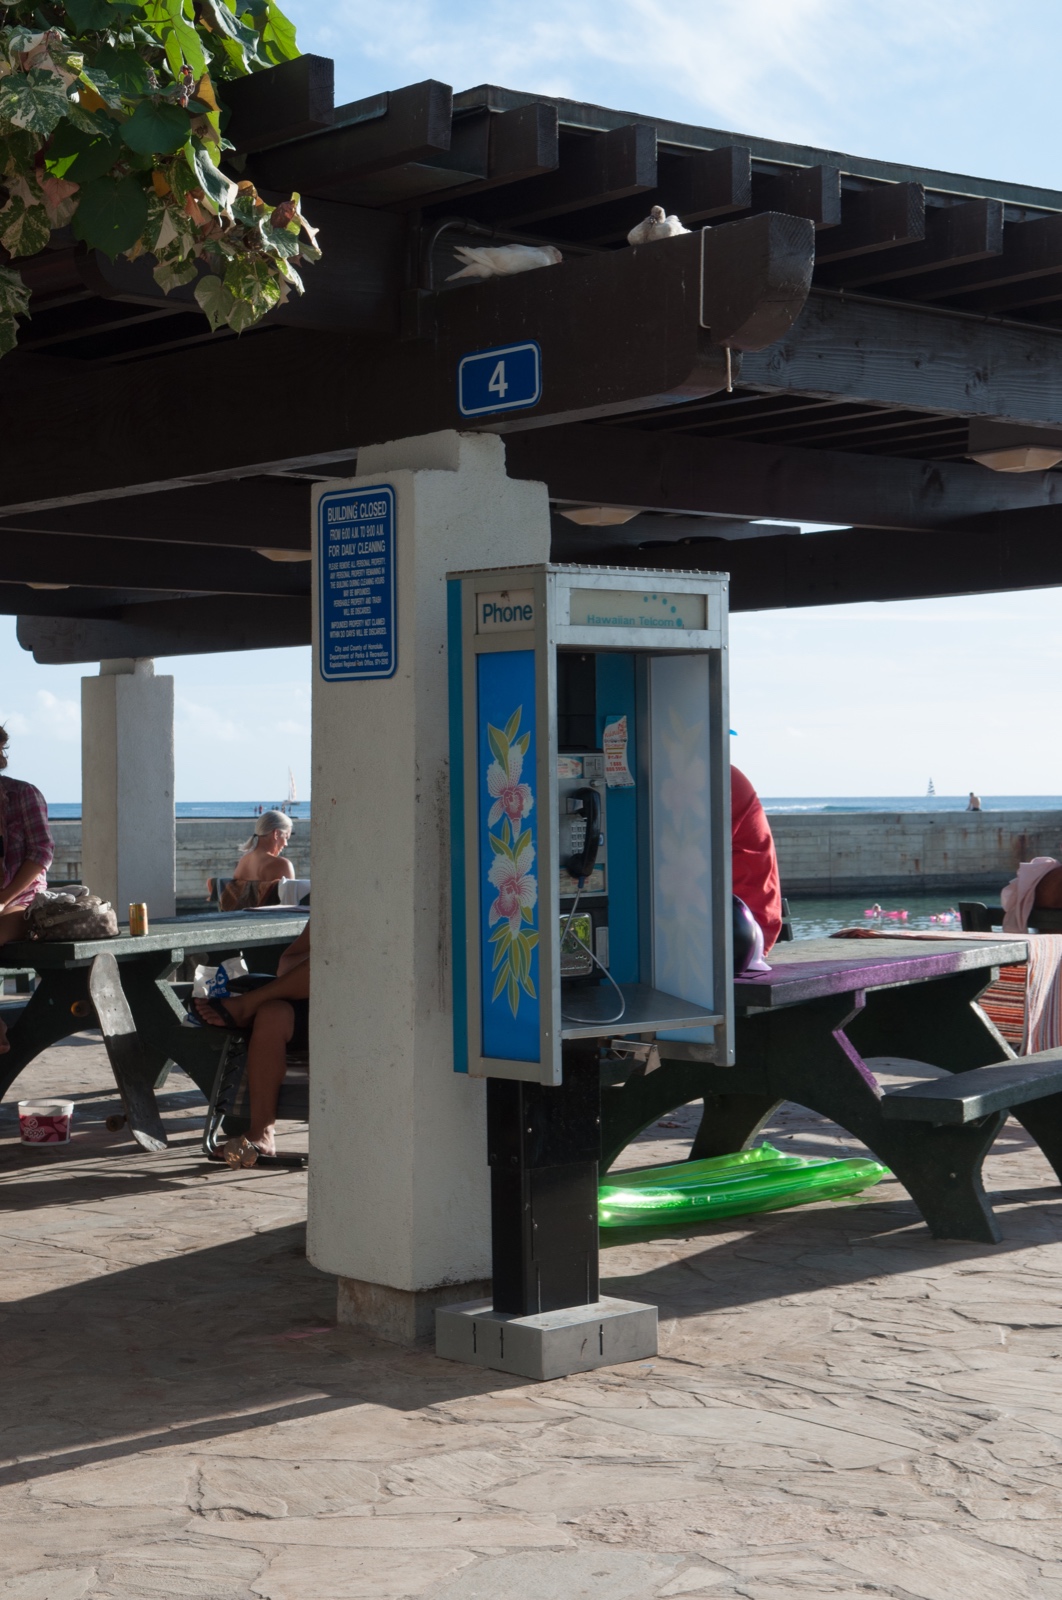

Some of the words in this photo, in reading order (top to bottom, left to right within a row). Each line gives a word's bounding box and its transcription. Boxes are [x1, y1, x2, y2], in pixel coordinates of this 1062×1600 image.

[488, 360, 508, 398] 4
[328, 505, 358, 522] BUILDING
[360, 501, 387, 518] CLOSED
[330, 529, 340, 540] FROM
[360, 526, 365, 537] TO
[329, 545, 340, 557] FOR
[342, 543, 356, 556] DAILY
[358, 540, 386, 554] CLEANING
[356, 559, 370, 567] PERSONAL
[351, 569, 365, 577] PROPERTY
[483, 603, 533, 624] Phone
[587, 614, 635, 626] Hawaiian
[639, 616, 674, 627] Telcom
[331, 621, 348, 629] IMPOUNDED
